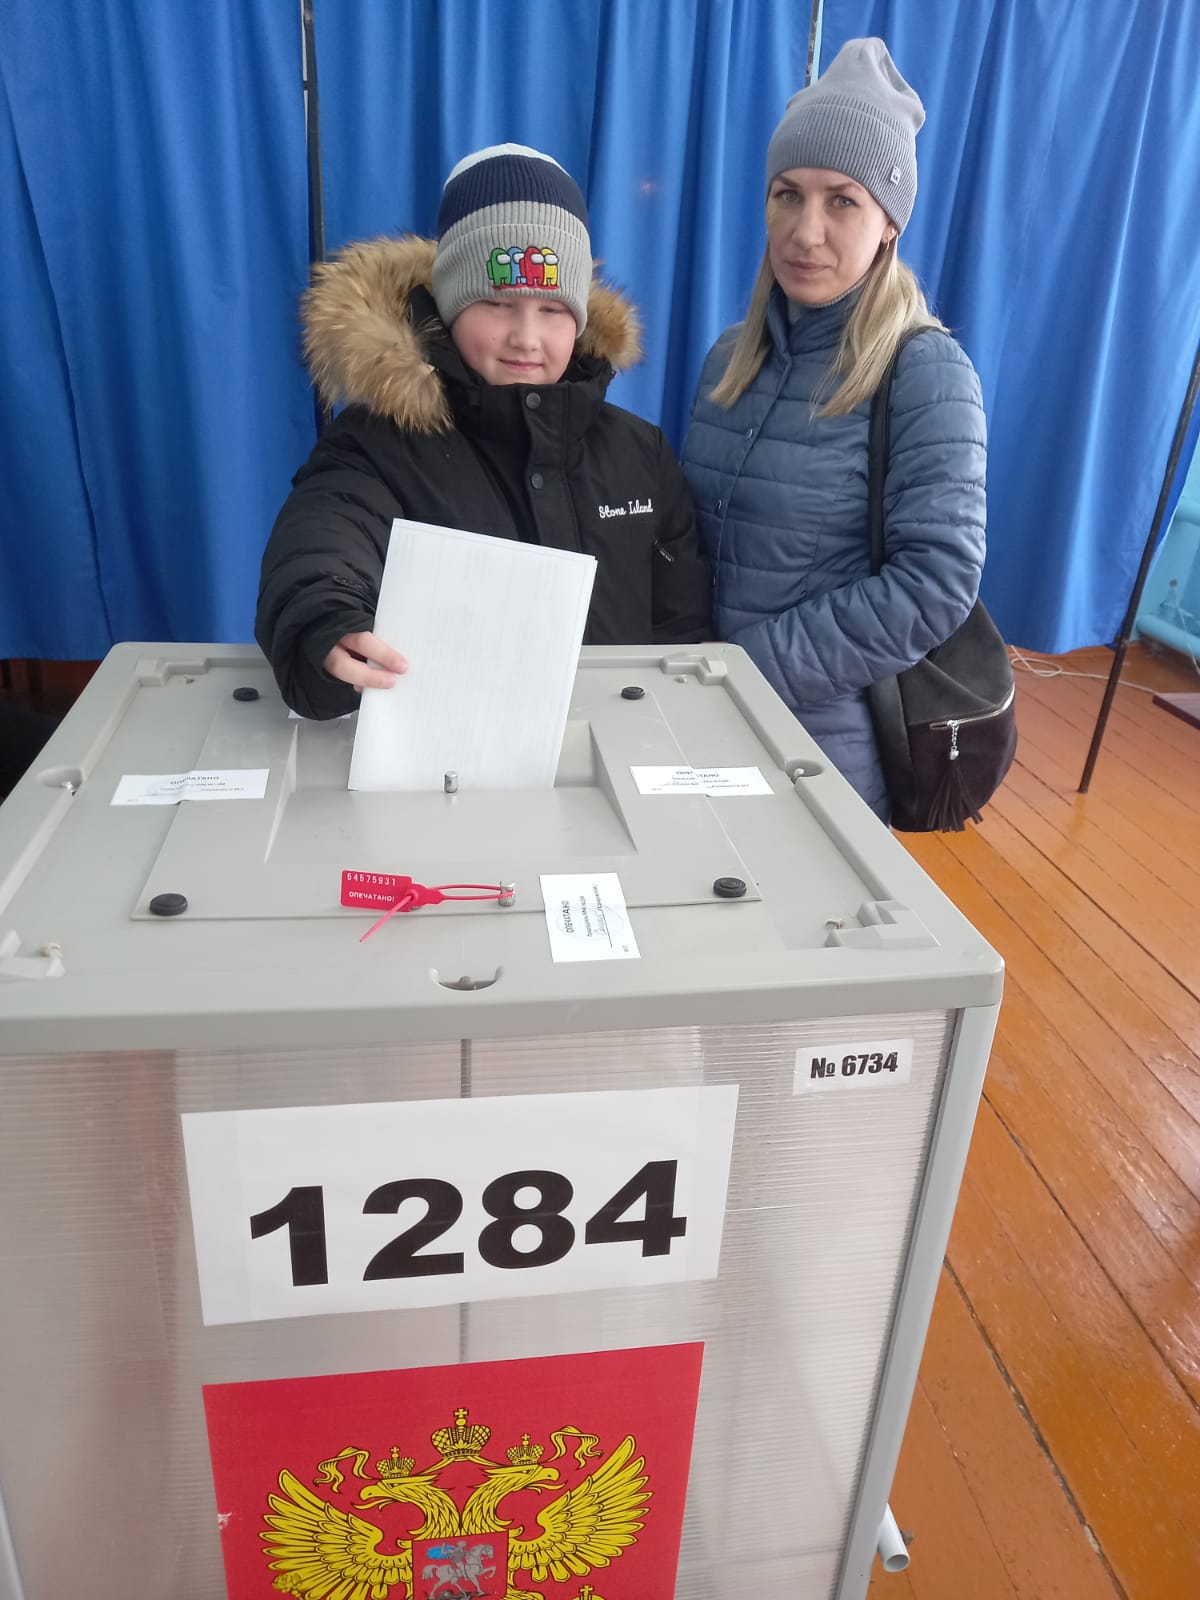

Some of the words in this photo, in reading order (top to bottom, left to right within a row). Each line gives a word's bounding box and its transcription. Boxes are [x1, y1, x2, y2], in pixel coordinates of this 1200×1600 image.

[598, 504, 627, 519] Stone
[628, 498, 653, 514] Island
[348, 890, 395, 902] ОПЕЧАТАНО!
[810, 1057, 836, 1079] №
[841, 1051, 899, 1077] 6734
[249, 1159, 688, 1287] 1284
